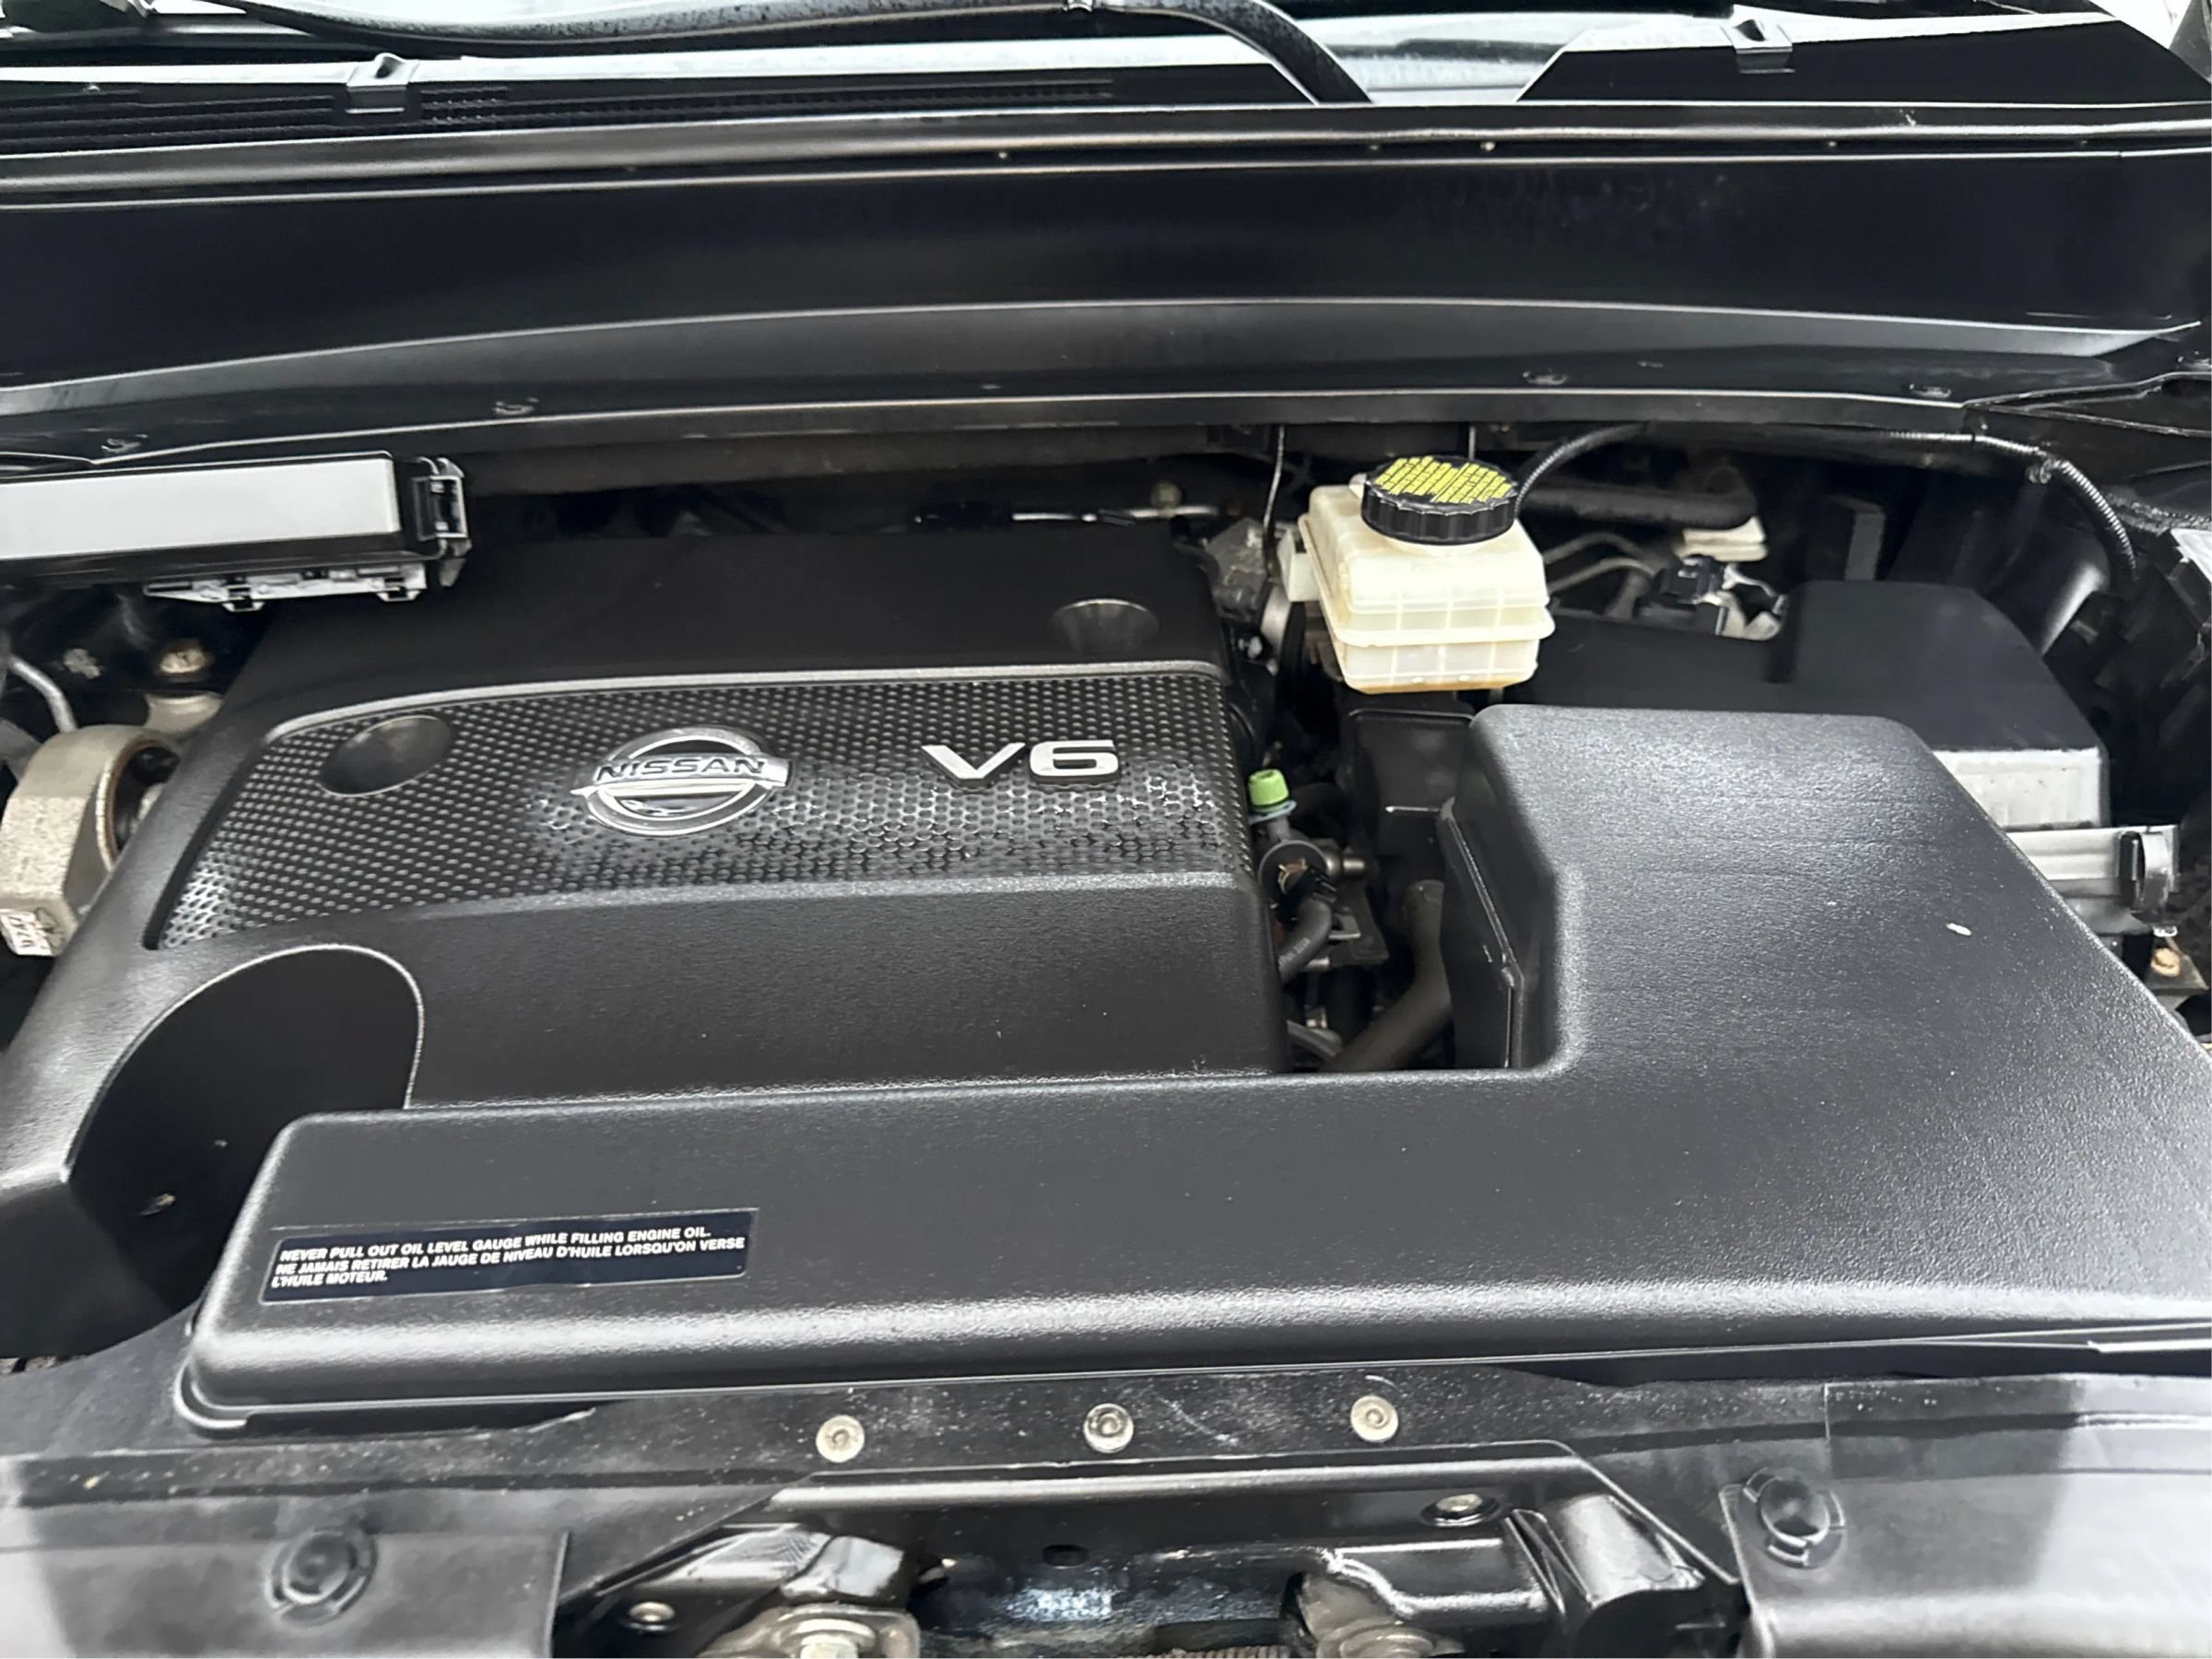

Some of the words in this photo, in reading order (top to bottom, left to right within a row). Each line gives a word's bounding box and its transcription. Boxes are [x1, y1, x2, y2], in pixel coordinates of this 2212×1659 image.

[594, 755, 768, 781] NISSAN
[921, 738, 1120, 787] V6
[276, 1263, 297, 1276] NE
[298, 1259, 349, 1274] JAMAIS
[351, 1256, 409, 1271] RETIRER
[412, 1254, 430, 1269] LA
[431, 1253, 478, 1267] JAUGE
[480, 1251, 501, 1265] DE
[503, 1246, 553, 1263] NIVEAU
[555, 1243, 613, 1259] D'HUILE
[614, 1239, 697, 1256] LORSQU'ON
[699, 1237, 747, 1251] VERSE
[280, 1246, 327, 1261] NEVER
[329, 1244, 365, 1259] PULL
[368, 1243, 399, 1257] OUT
[400, 1241, 424, 1255] OIL
[427, 1239, 468, 1253] LEVEL
[471, 1236, 523, 1252] GAUGE
[524, 1232, 568, 1247] WHILE
[571, 1230, 625, 1244] FILLING
[628, 1228, 681, 1242] ENGINE
[684, 1226, 712, 1239] OIL.
[271, 1273, 324, 1288] L'HUILE
[325, 1270, 388, 1286] MOTEUR.
